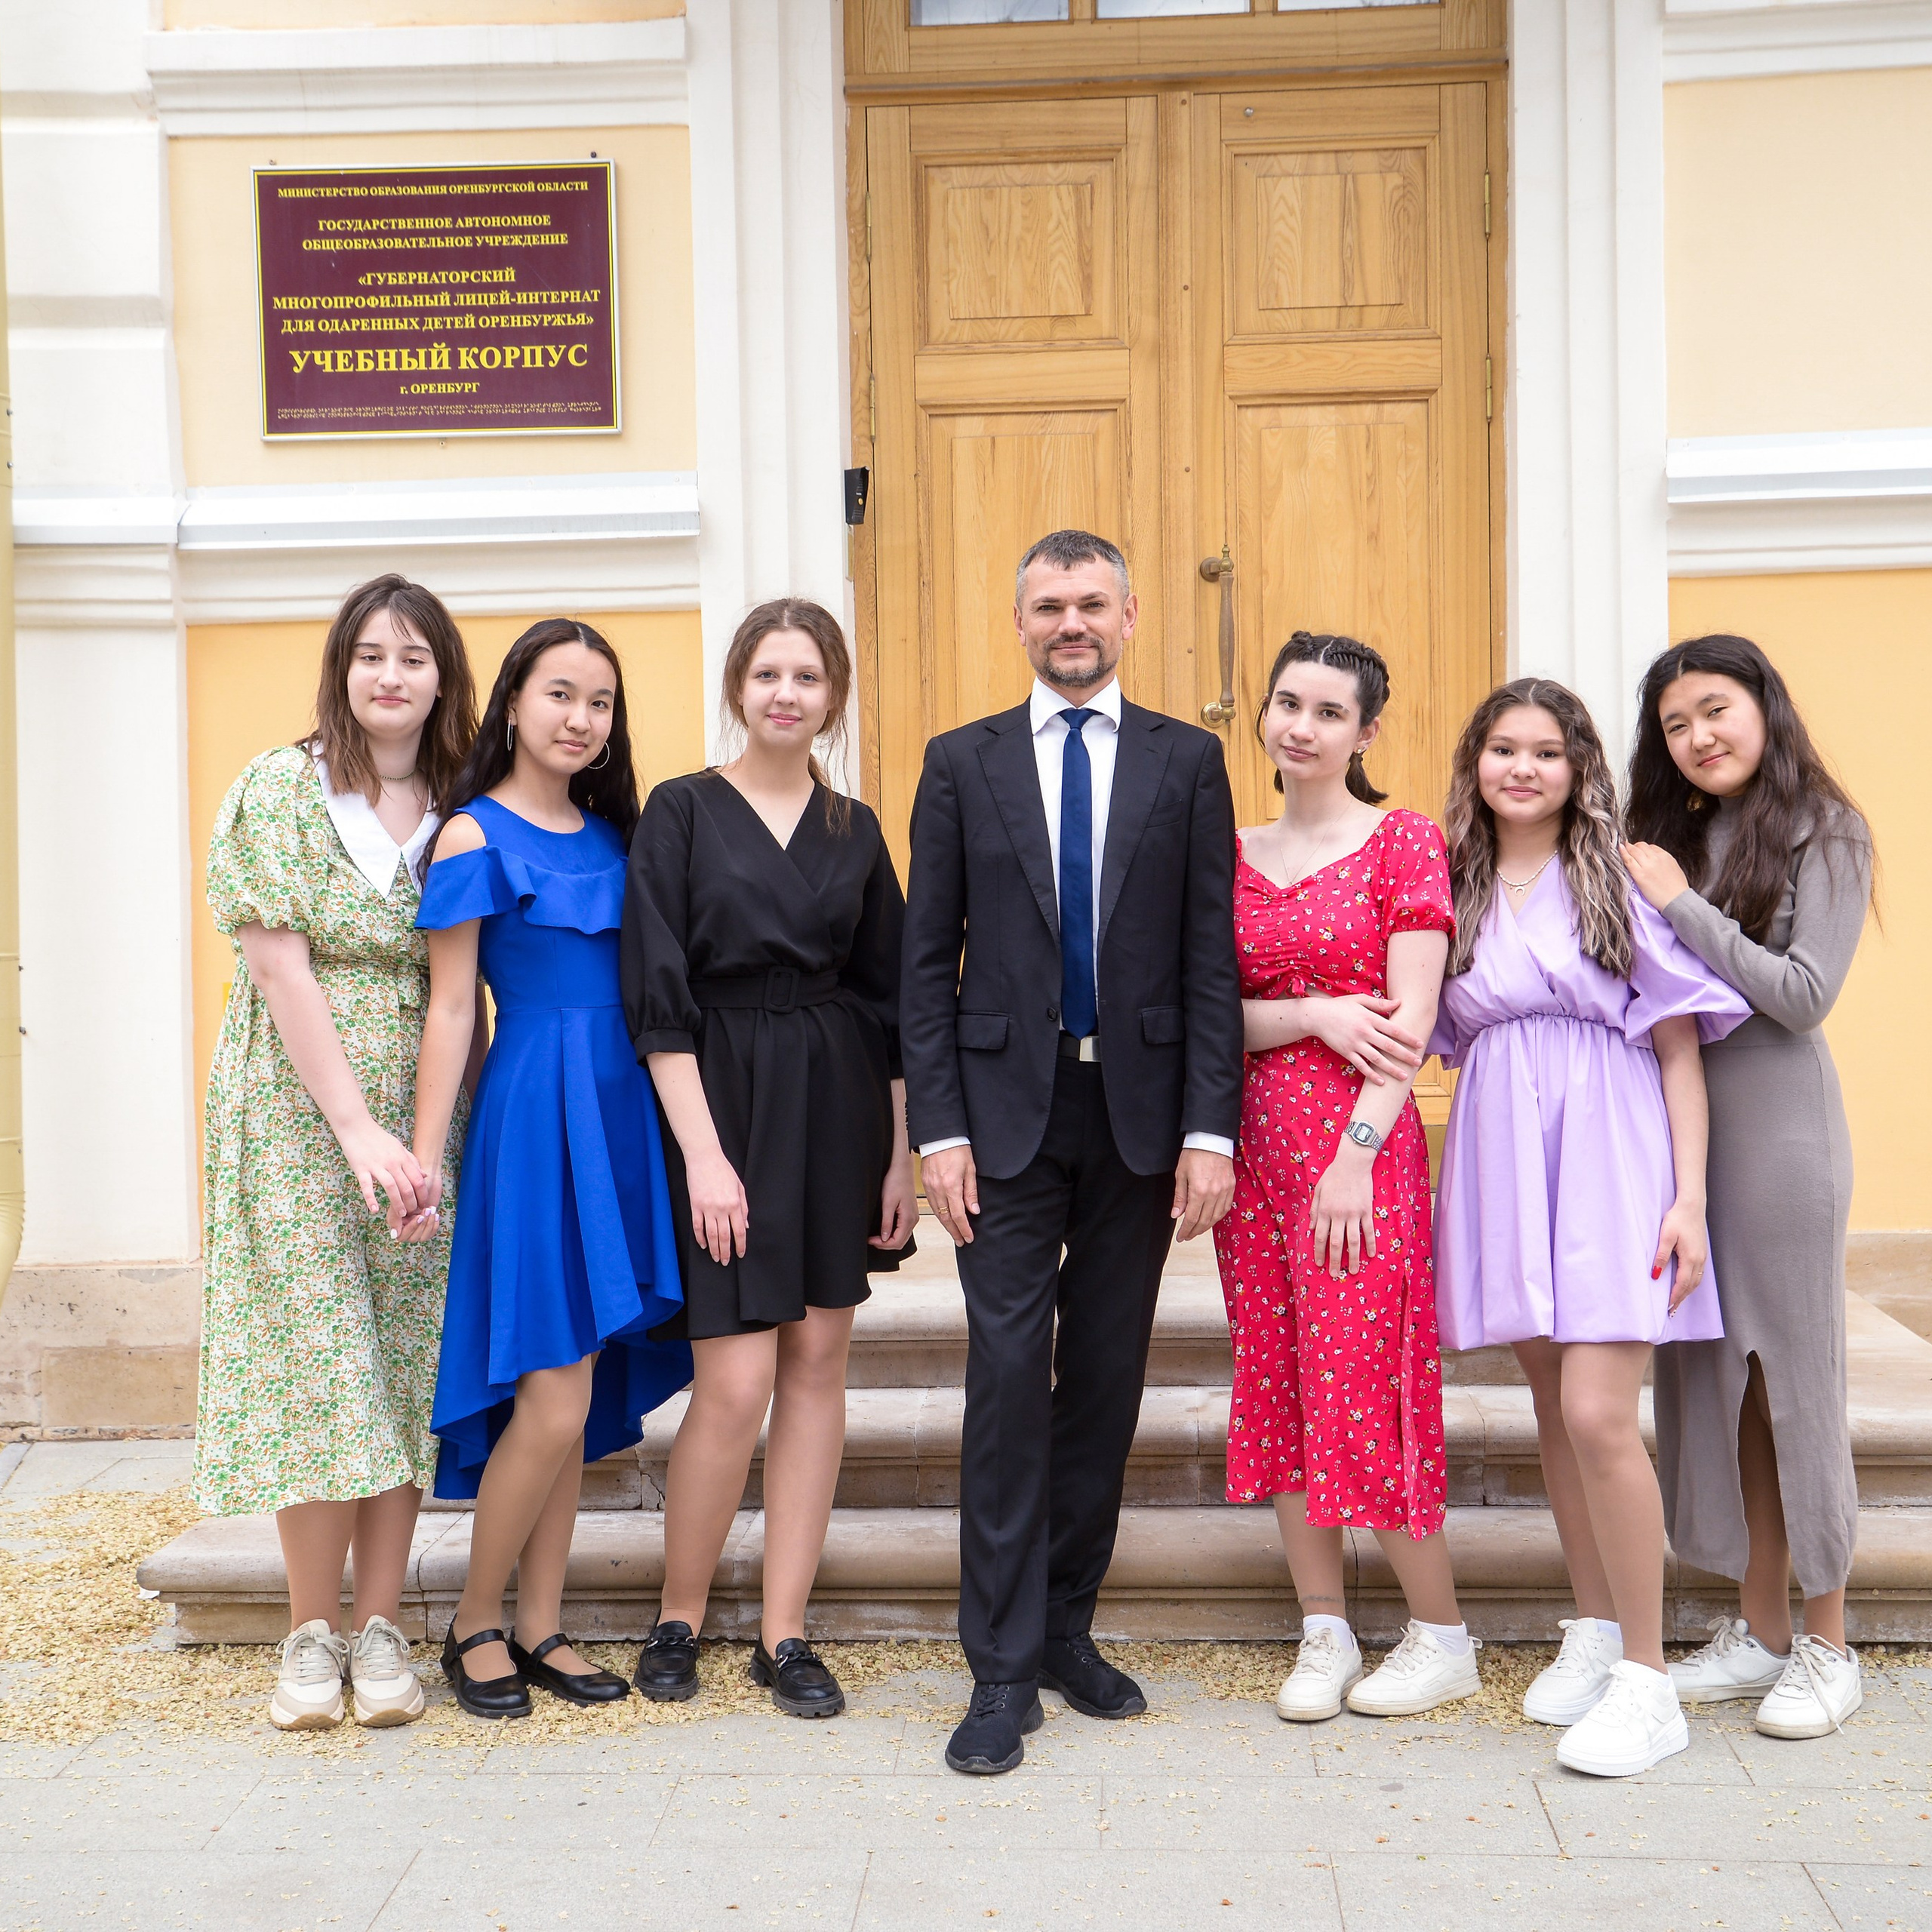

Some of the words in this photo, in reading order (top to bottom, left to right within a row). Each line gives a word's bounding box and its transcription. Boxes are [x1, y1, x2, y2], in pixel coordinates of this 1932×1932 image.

[277, 186, 368, 198] МИНИСТЕРСТВО
[369, 184, 448, 197] ОБРАЗОВАНИЯ
[448, 180, 536, 195] ОРЕНБУРГСКОЙ
[537, 180, 589, 192] ОБЛАСТИ
[318, 217, 454, 232] ГОСУДАРСТВЕННОЕ
[455, 214, 552, 229] АВТОНОМНОЕ
[302, 235, 473, 252] ОБЩЕОБРАЗОВАТЕЛЬНОЕ
[475, 232, 569, 248] УЧРЕЖДЕНИЕ
[358, 266, 515, 286] «ГУБЕРНАТОРСКИЙ
[272, 291, 451, 310] МНОГОПРОФИЛЬНЫЙ
[453, 289, 601, 307] ЛИЦЕЙ-ИНТЕРНАТ
[281, 318, 315, 334] ДЛЯ
[317, 317, 420, 334] ОДАРЕННЫХ
[422, 312, 476, 332] ДЕТЕЙ
[478, 312, 594, 329] ОРЕНБУРЖЬЯ»
[288, 341, 452, 374] УЧЕБНЫЙ
[457, 343, 588, 370] КОРПУС
[399, 386, 409, 395] г.
[410, 382, 480, 395] ОРЕНБУРГ
